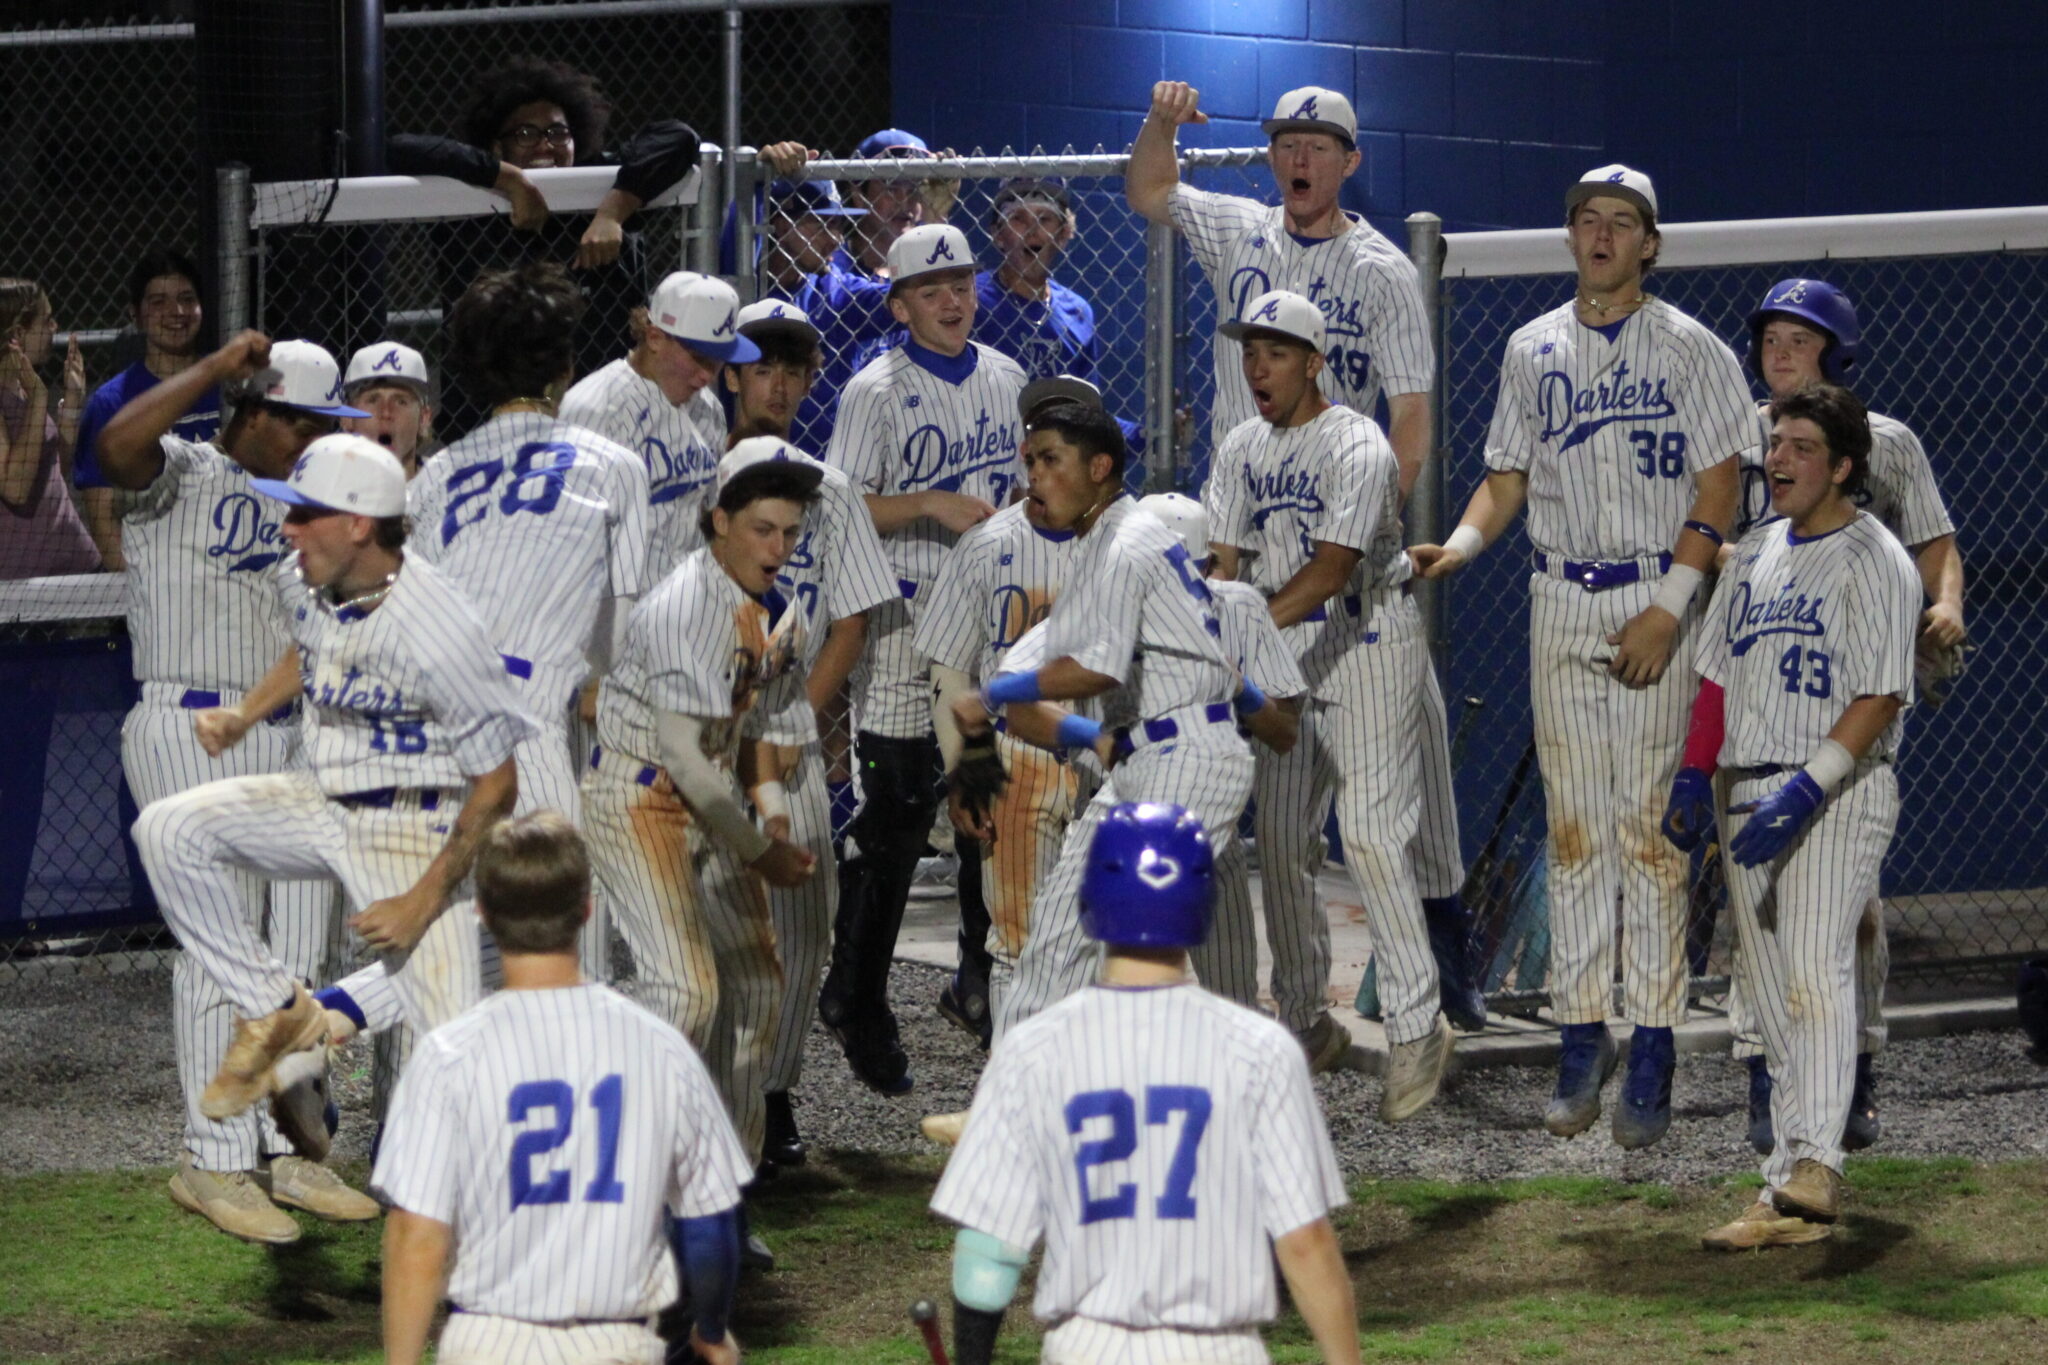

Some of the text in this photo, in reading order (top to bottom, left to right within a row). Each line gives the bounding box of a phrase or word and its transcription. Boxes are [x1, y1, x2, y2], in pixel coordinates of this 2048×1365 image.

[1289, 95, 1318, 120] A
[926, 235, 954, 265] A
[713, 307, 736, 337] A
[1250, 298, 1280, 323] A
[372, 349, 402, 372] A
[1537, 360, 1677, 446] Darters
[899, 407, 1016, 490] Darters
[1629, 429, 1687, 480] 38
[441, 441, 577, 550] 28
[1726, 575, 1825, 644] Darters
[1778, 644, 1832, 699] 43
[507, 1073, 624, 1213] 21
[1063, 1083, 1213, 1226] 27
